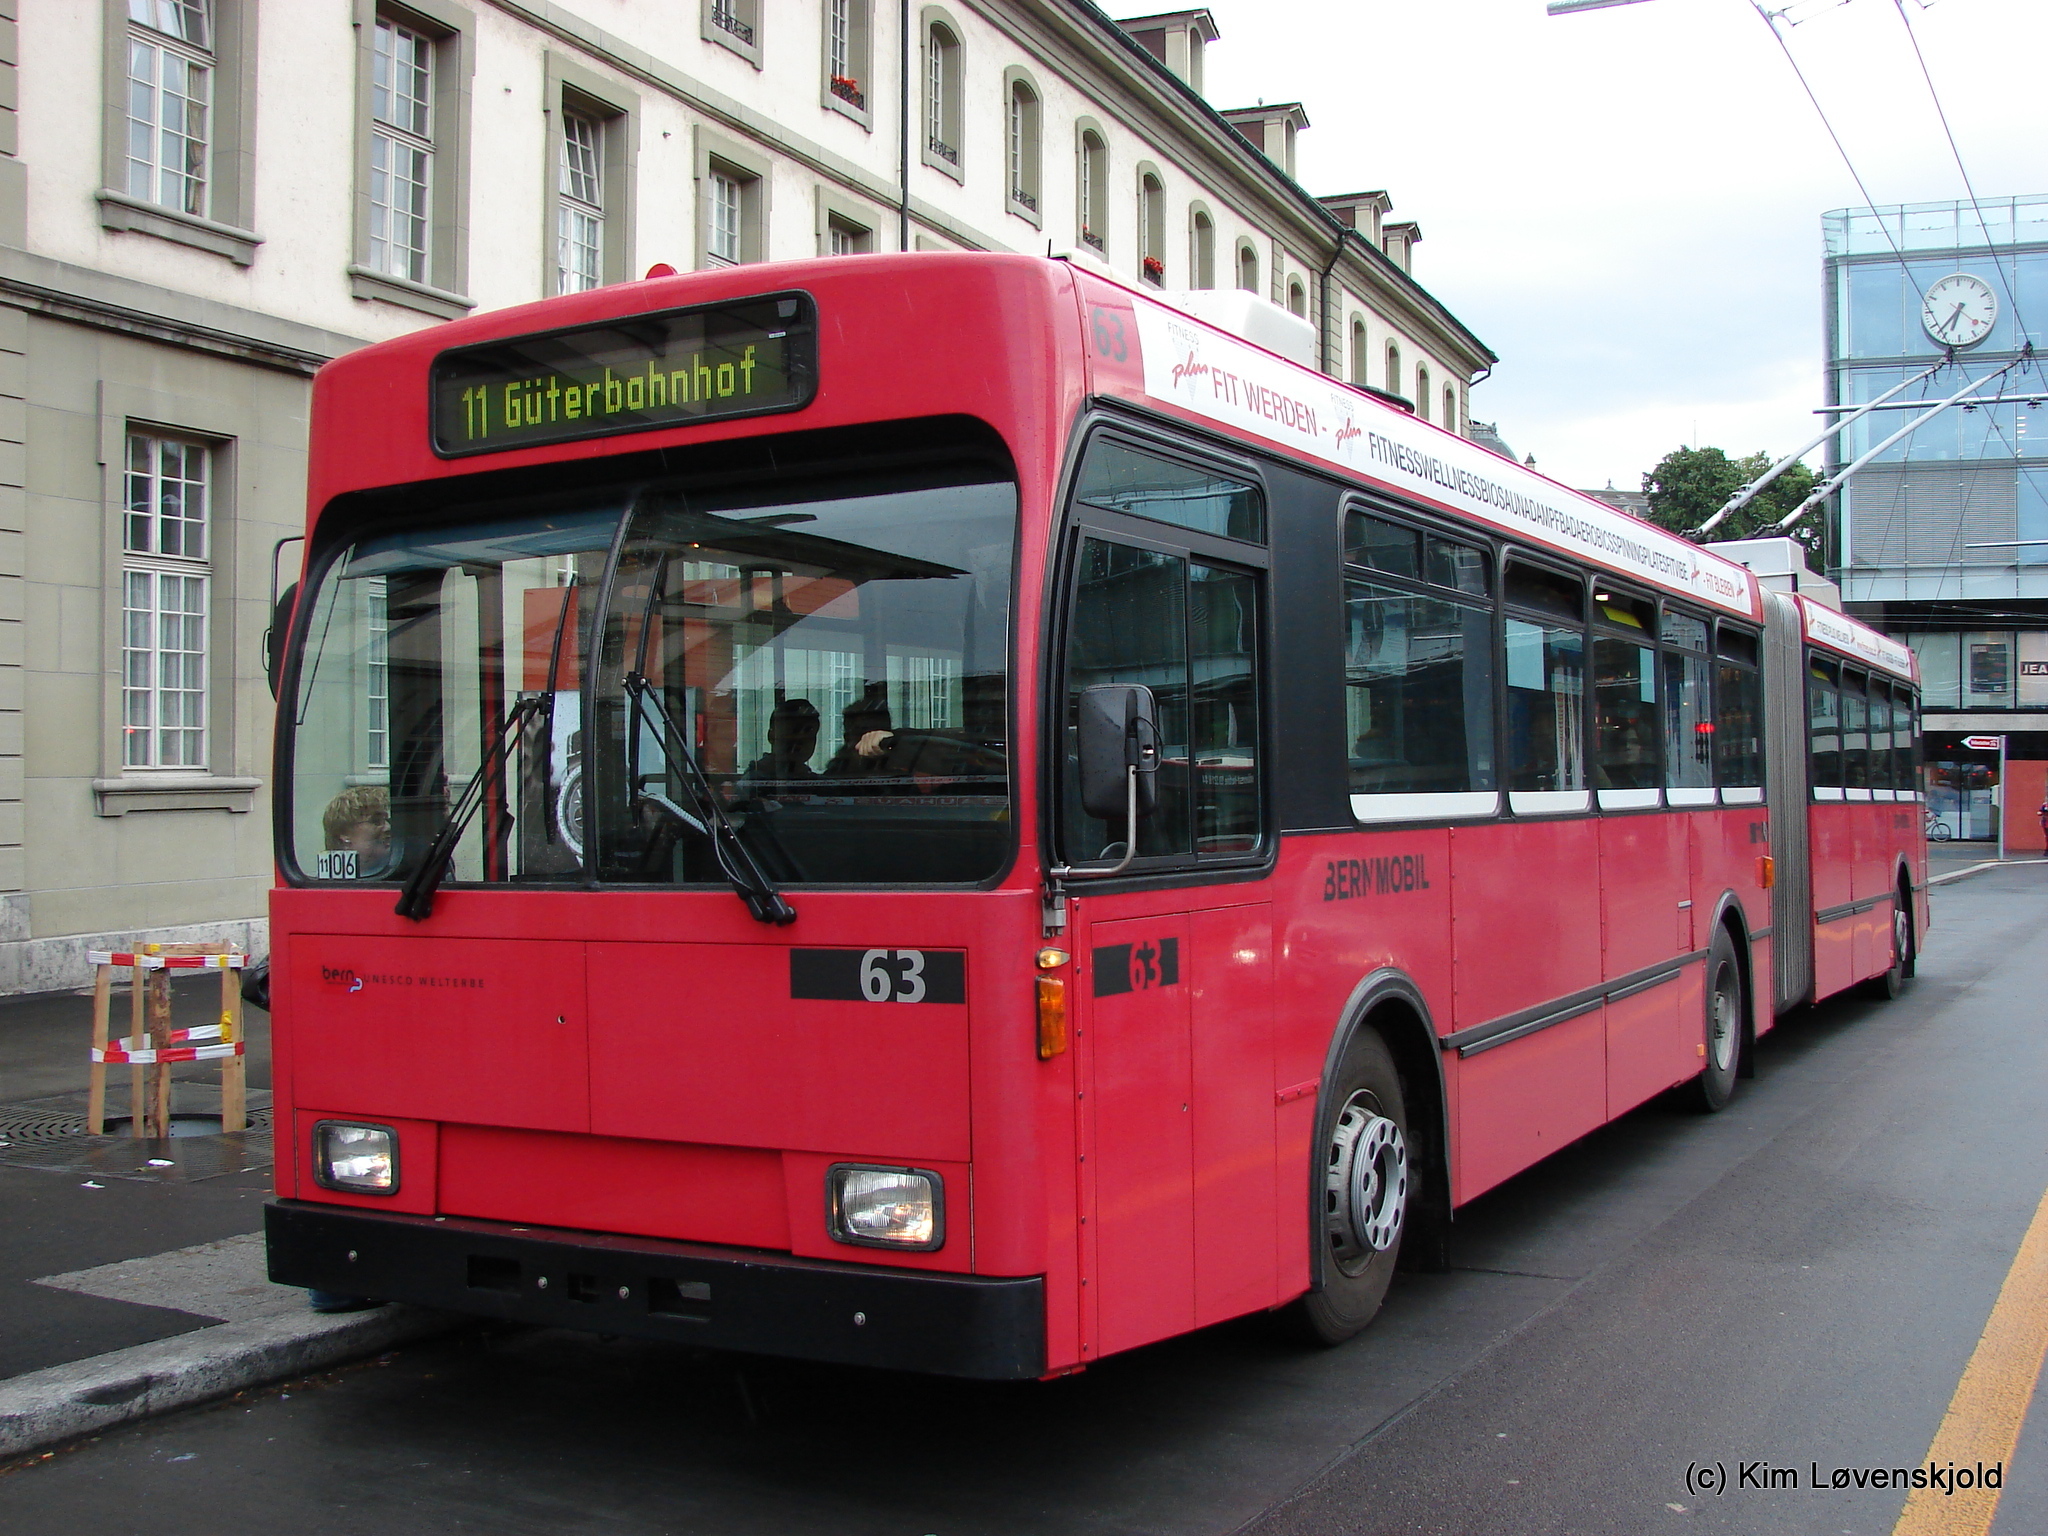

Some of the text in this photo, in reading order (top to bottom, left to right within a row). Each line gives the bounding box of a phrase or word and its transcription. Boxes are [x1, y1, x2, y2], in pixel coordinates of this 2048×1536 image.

[1093, 307, 1128, 363] 63
[462, 345, 755, 440] 11 Güterbahnhof
[1211, 366, 1238, 406] FIT
[1242, 379, 1318, 438] WERDEN
[322, 965, 355, 982] bern
[364, 974, 413, 986] UNESCO
[419, 977, 485, 988] WELTERBE
[859, 949, 927, 1004] 63
[1128, 938, 1162, 993] 63
